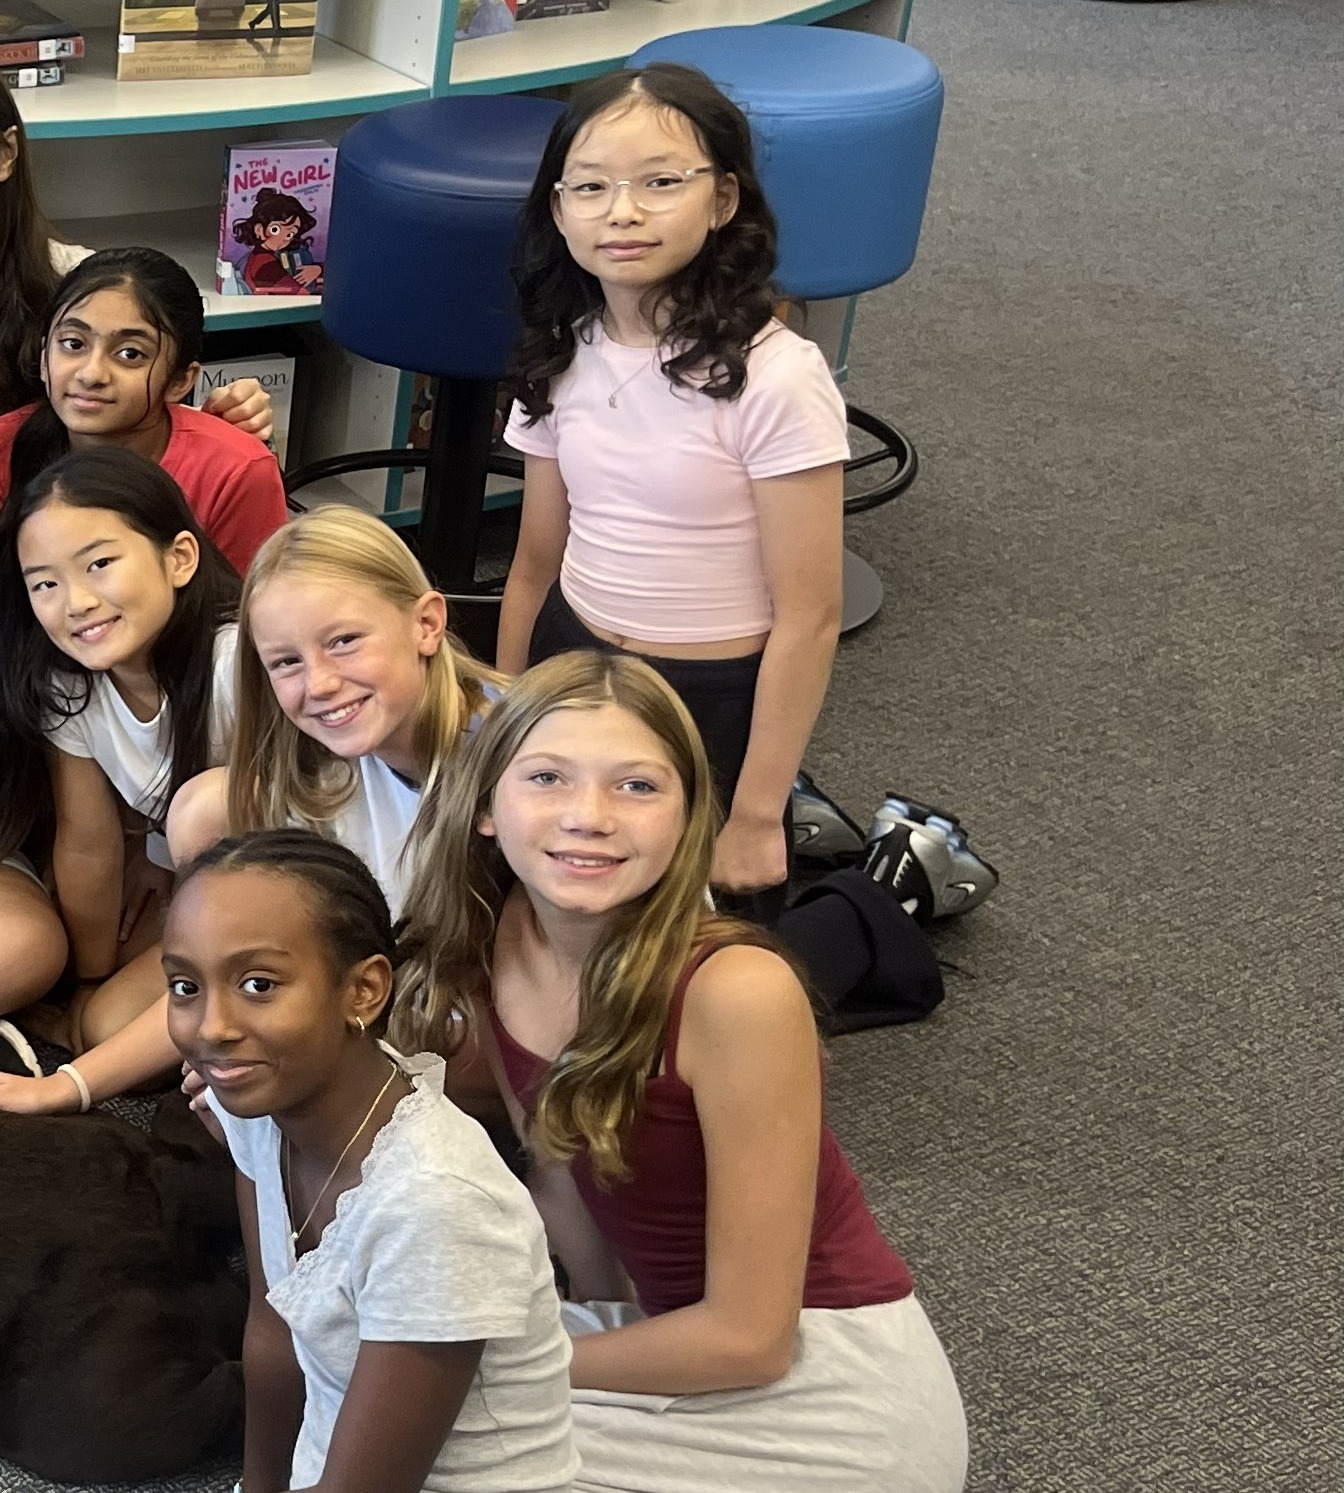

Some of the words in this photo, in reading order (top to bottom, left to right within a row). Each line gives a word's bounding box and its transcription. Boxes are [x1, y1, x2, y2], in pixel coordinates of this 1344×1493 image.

[248, 158, 269, 168] THE
[234, 165, 278, 194] NEW
[280, 164, 331, 189] GIRL
